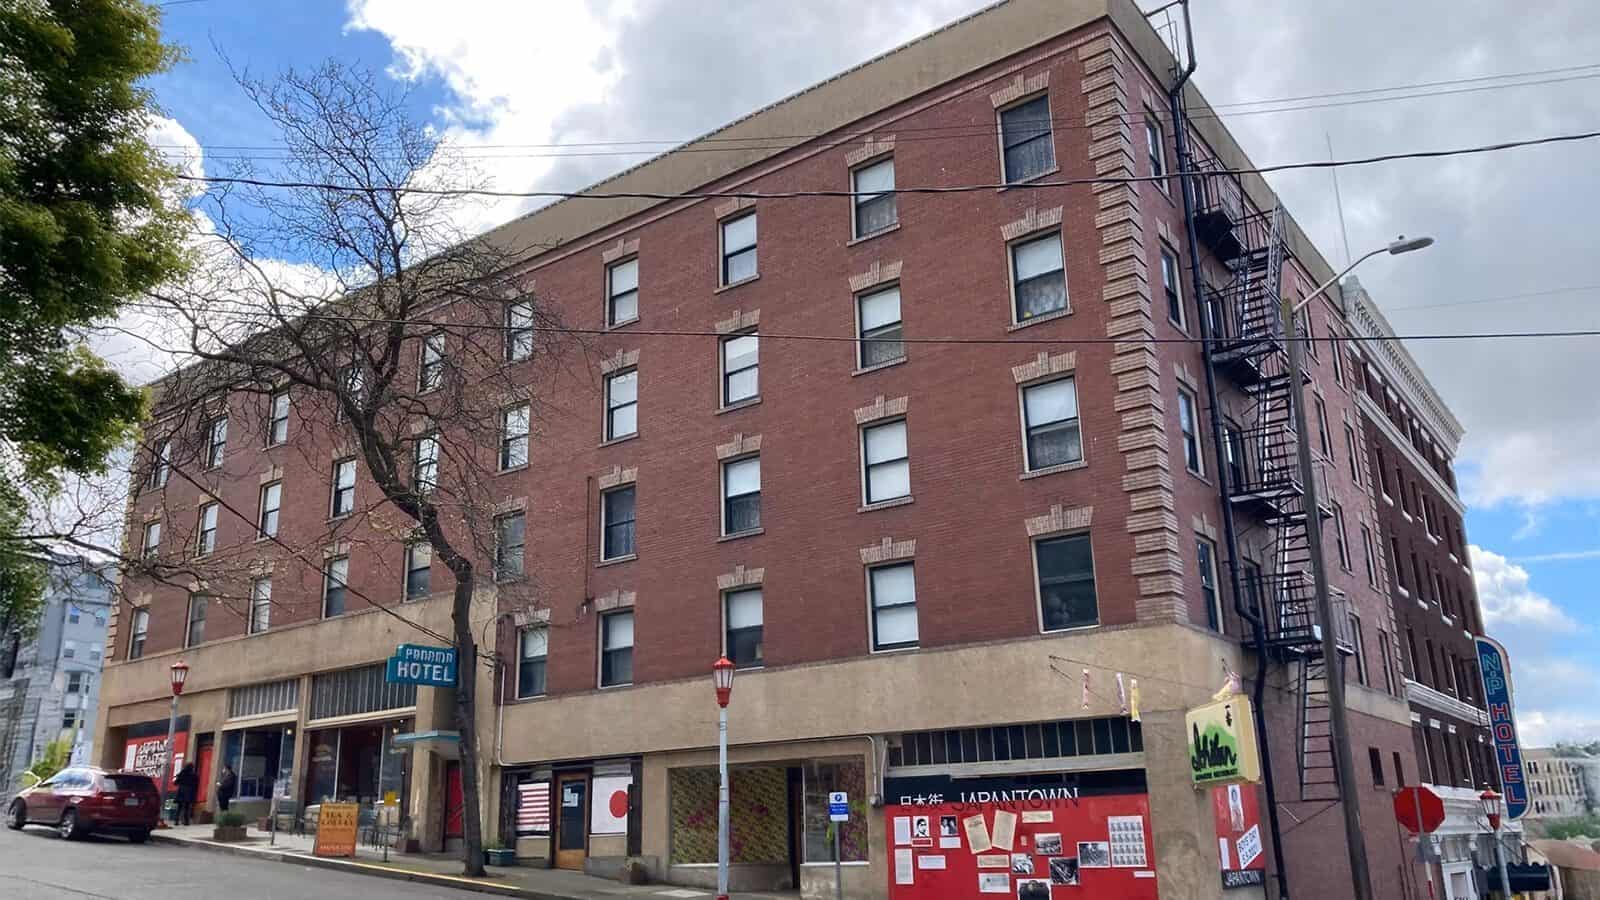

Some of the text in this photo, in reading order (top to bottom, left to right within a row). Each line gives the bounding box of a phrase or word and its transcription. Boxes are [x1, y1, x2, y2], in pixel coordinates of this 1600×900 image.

[405, 648, 453, 663] PANAMA
[397, 660, 454, 682] HOTEL
[1490, 703, 1526, 804] HOTEL
[961, 787, 1078, 804] JAPANTOWN
